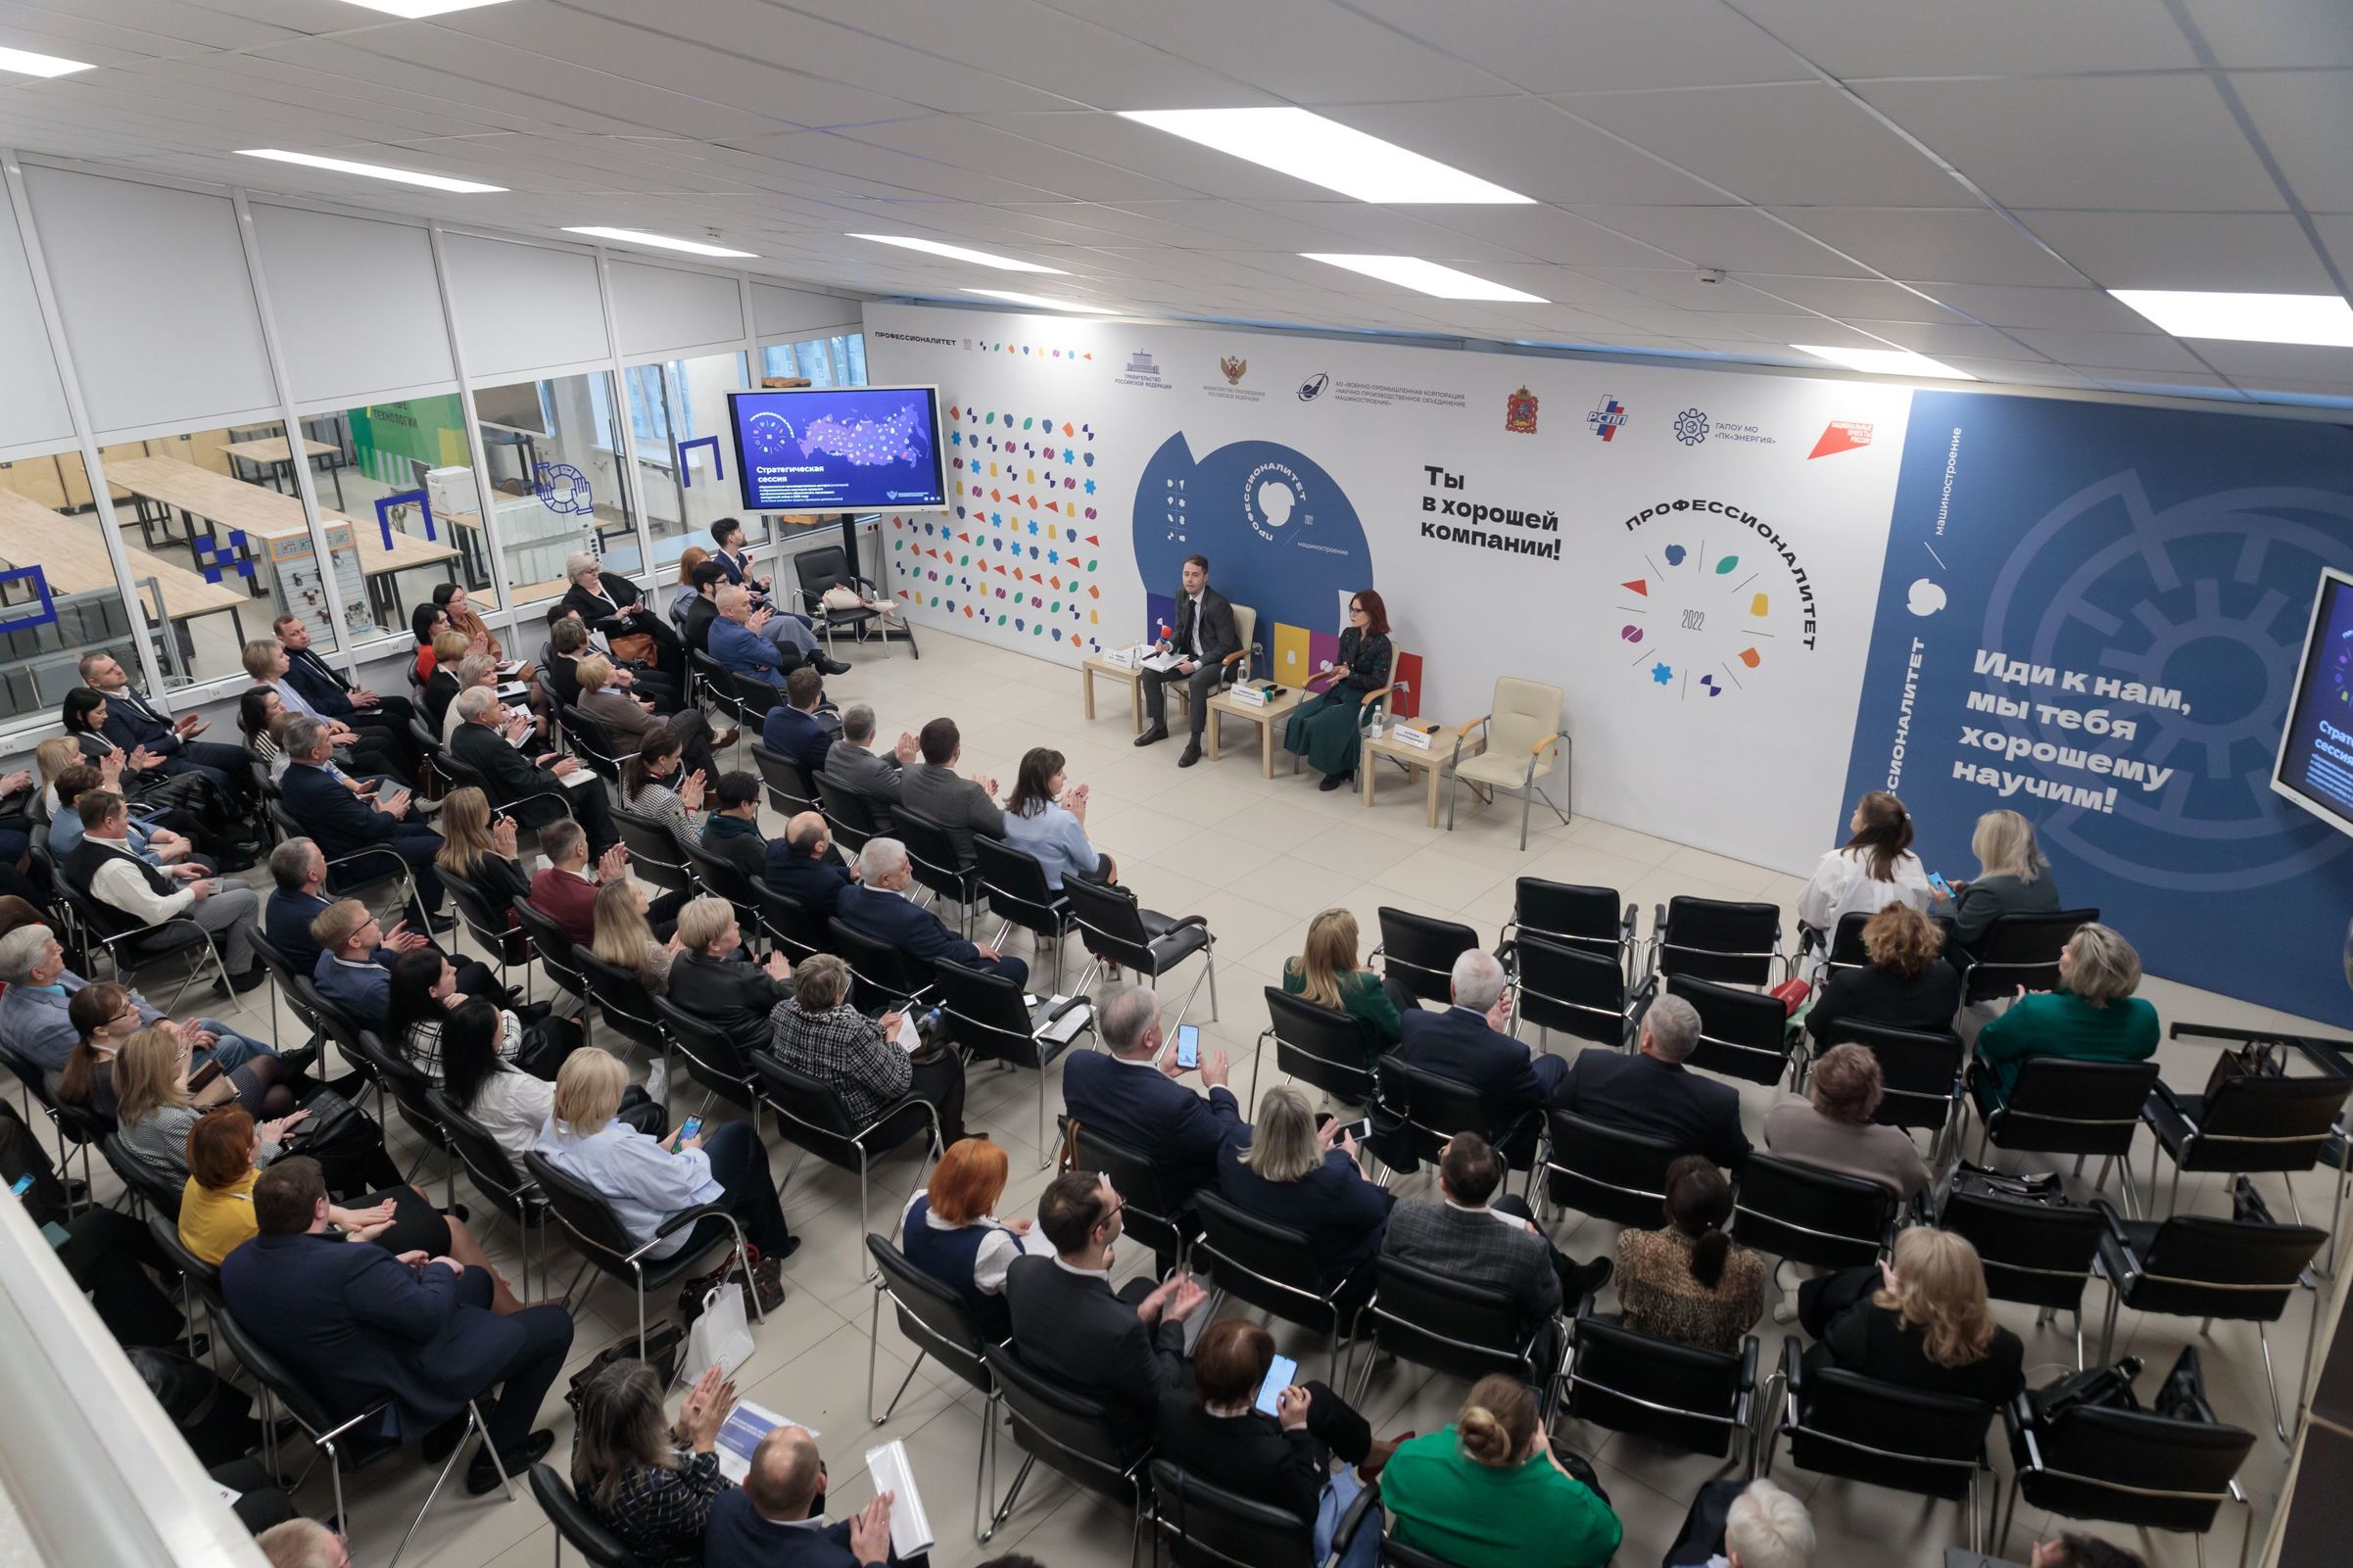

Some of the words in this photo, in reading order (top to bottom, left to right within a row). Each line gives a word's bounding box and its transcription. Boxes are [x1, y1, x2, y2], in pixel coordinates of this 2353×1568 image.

[875, 331, 956, 346] ПРОФЕССИОНАЛИТЕТ
[1587, 411, 1628, 425] РСПП
[1715, 422, 1743, 432] ГАПОУ
[756, 466, 824, 475] Стратегическая
[1424, 465, 1465, 490] Ты
[1935, 427, 1962, 536] машиностроение
[1244, 462, 1307, 542] ПРОФЕССИОНАЛИТЕТ
[1422, 496, 1437, 512] в
[1441, 499, 1559, 532] хорошей
[1297, 542, 1349, 556] машиностроение
[1420, 522, 1561, 560] компании!
[1625, 499, 1816, 650] ПРОФЕССИОНАЛИТЕТ
[1681, 609, 1705, 632] 2022
[1974, 649, 2056, 686] Иди
[2061, 671, 2089, 693] к
[2093, 676, 2191, 716] нам,
[1886, 637, 1925, 797] СИОНАЛИТЕТ
[1966, 690, 2030, 720] мы
[2036, 704, 2137, 741] тебя
[1958, 726, 2174, 791] хорошему
[1952, 761, 2118, 814] научим!
